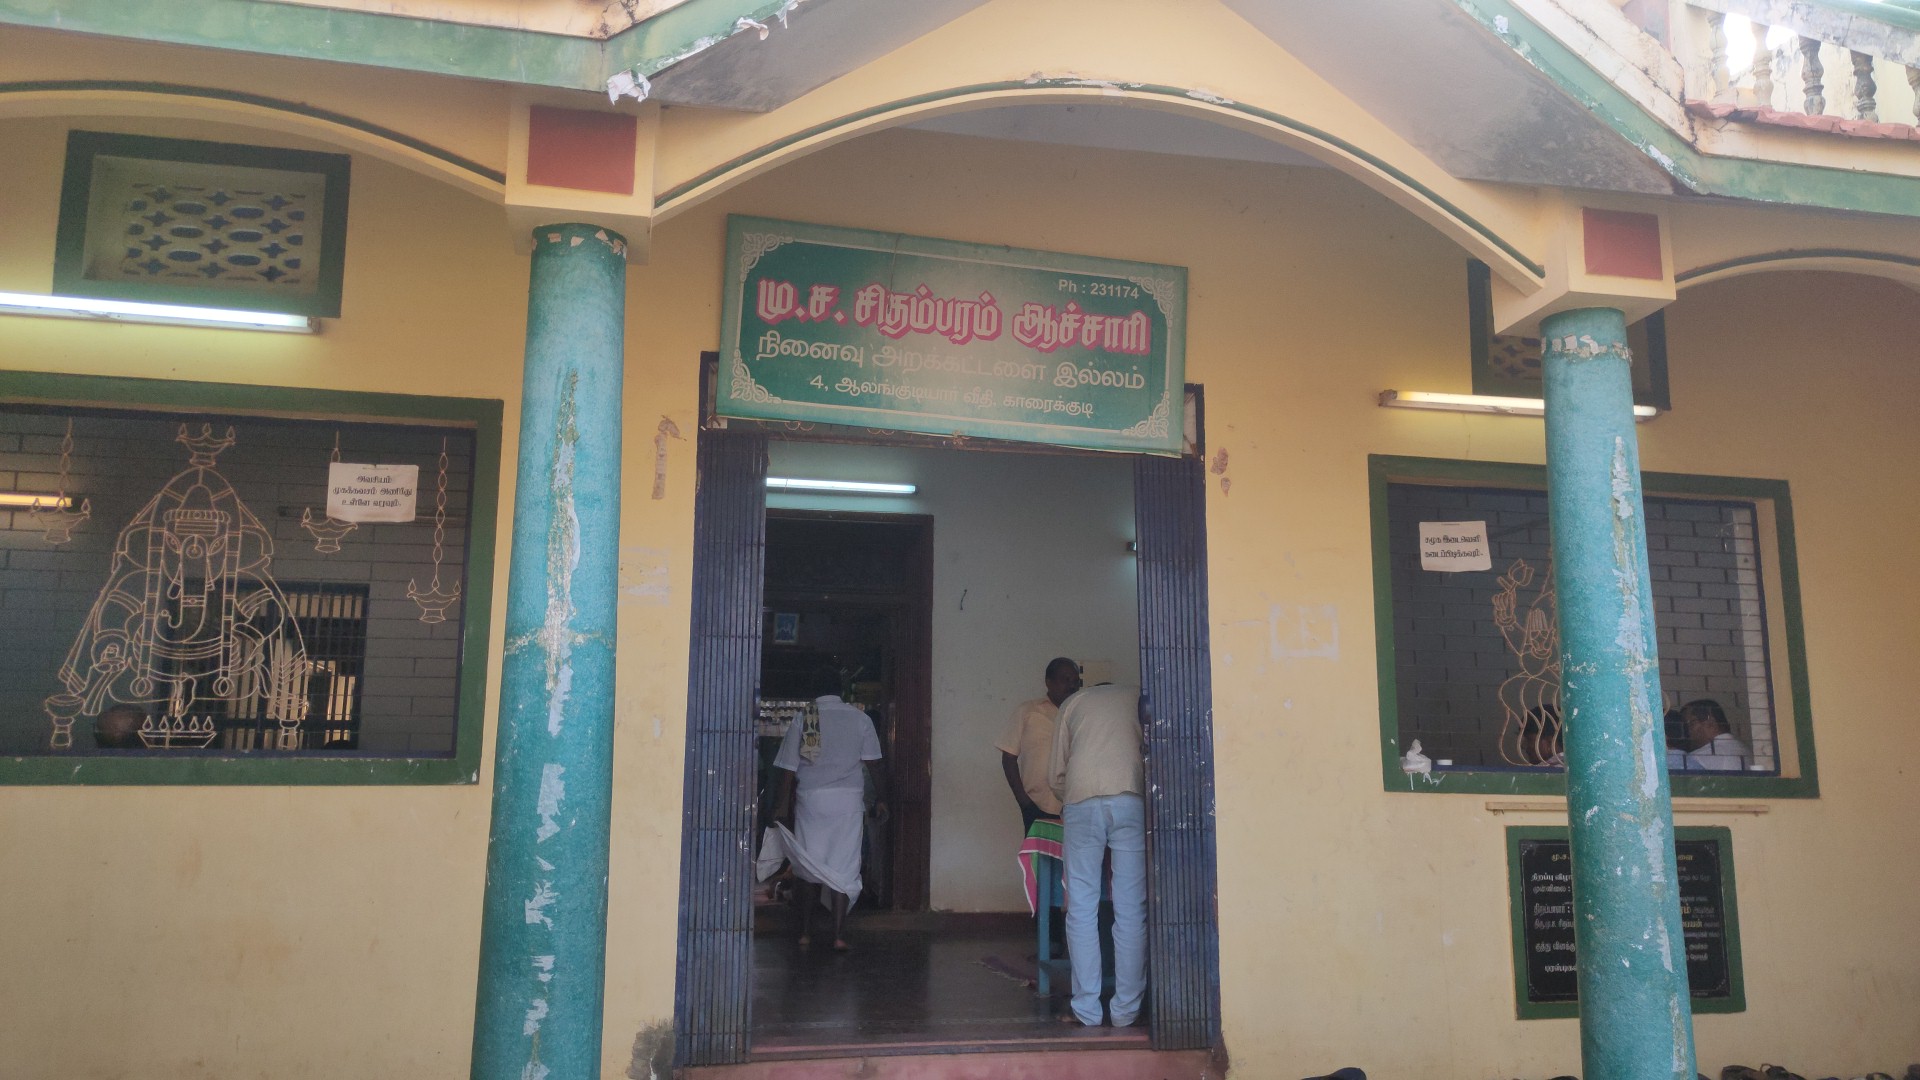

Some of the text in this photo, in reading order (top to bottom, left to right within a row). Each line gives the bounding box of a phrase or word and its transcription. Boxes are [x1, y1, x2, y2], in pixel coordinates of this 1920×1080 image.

[1058, 279, 1077, 293] Ph
[1090, 282, 1139, 299] 231174
[854, 282, 1003, 346] சிதம்பரம்
[1012, 300, 1151, 355] ஆச்சாரி
[756, 330, 1145, 389] நினைவு அறக்கட்டளை இல்லம்
[810, 375, 829, 392] 4,
[835, 377, 958, 402] ஆலங்குடியார்
[1003, 395, 1094, 418] காரைக்குடி
